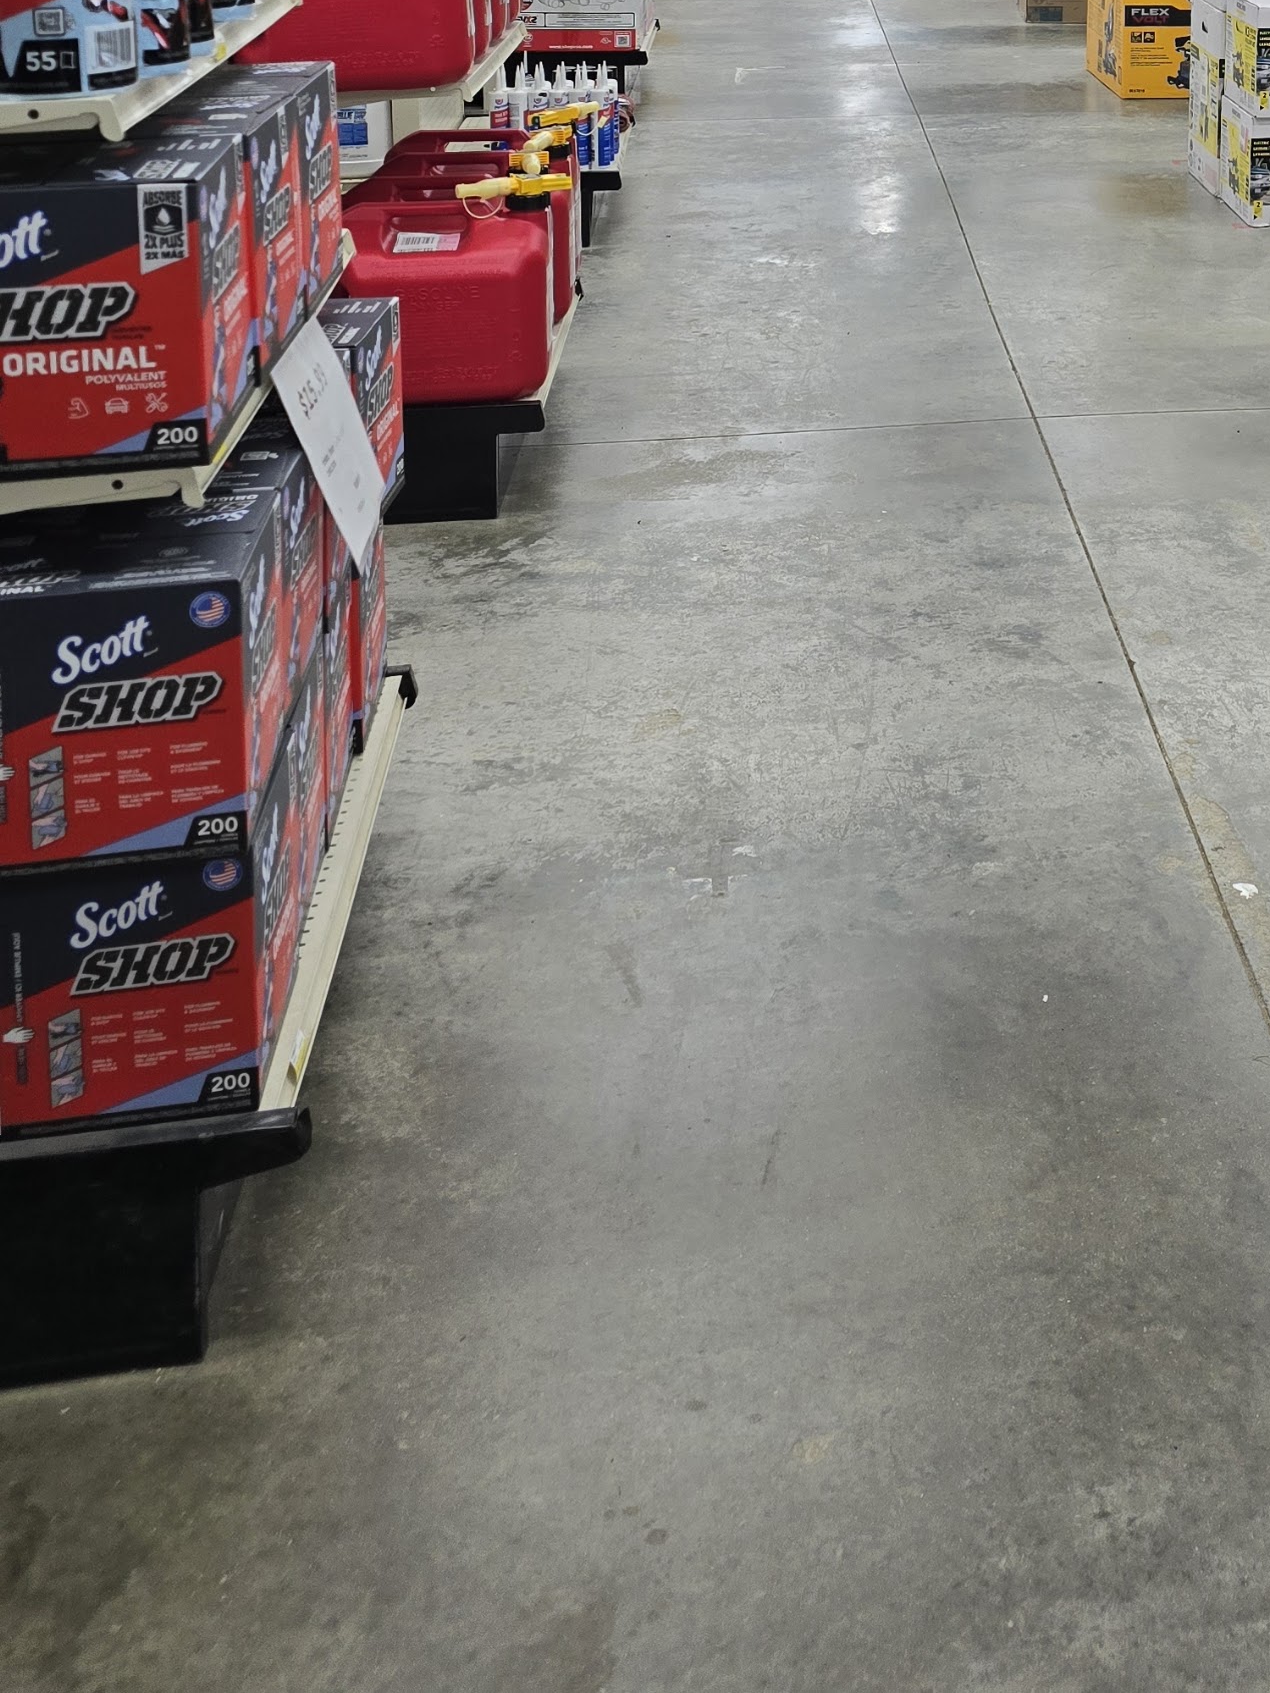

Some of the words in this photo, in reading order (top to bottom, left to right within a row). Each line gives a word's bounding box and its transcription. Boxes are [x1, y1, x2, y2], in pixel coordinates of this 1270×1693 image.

[1131, 8, 1170, 16] FLEX
[1133, 16, 1168, 24] VOLT
[26, 51, 57, 72] 55
[142, 190, 183, 206] ABSORBE
[0, 210, 47, 268] ott
[159, 234, 185, 249] PLUS
[0, 281, 136, 342] HOP
[3, 345, 157, 377] ORIGINAL
[85, 371, 166, 385] POLYVALENT
[115, 382, 167, 392] MULTIUSOS
[367, 362, 394, 430] SHOP
[157, 427, 199, 445] 200
[52, 614, 150, 686] Scott
[52, 671, 224, 735] SHOP
[198, 816, 239, 836] 200
[70, 880, 164, 950] Scott
[70, 933, 235, 995] SHOP
[211, 1072, 251, 1093] 200
